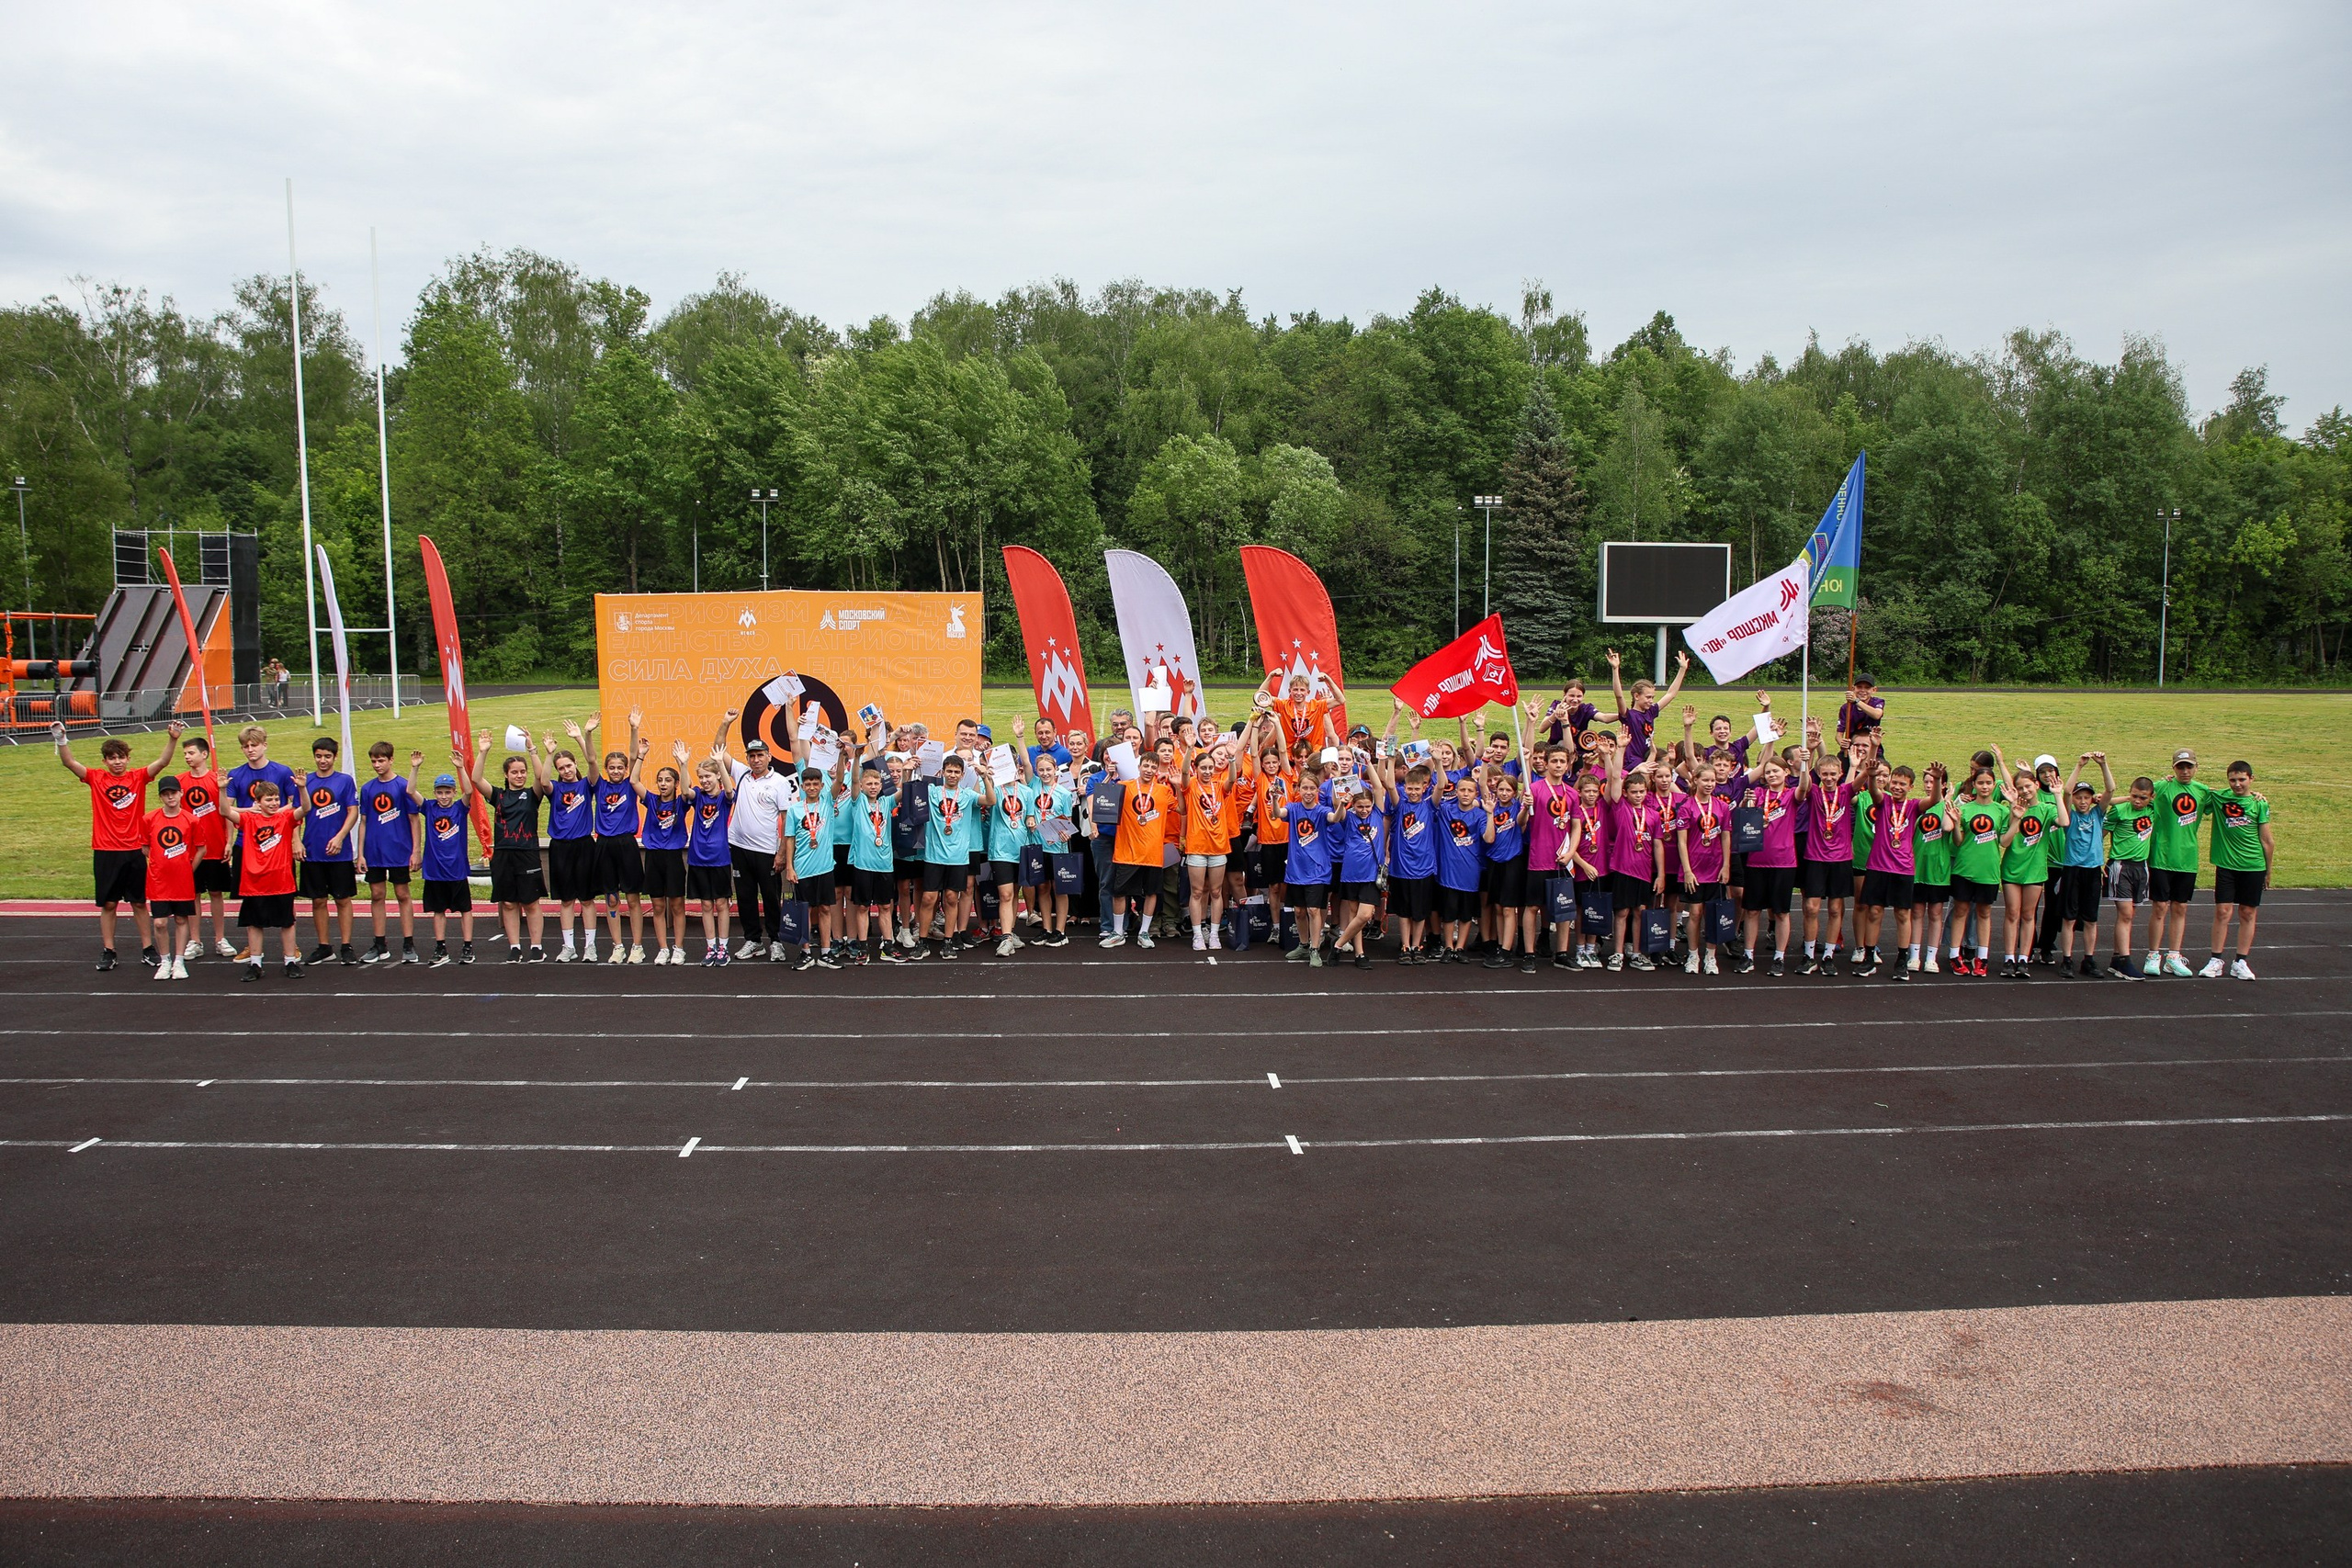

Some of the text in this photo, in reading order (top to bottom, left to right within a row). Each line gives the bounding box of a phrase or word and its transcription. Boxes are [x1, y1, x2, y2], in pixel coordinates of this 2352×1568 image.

[838, 607, 886, 620] МОСКОВСКИЙ
[838, 620, 861, 630] СПОРТ
[607, 629, 770, 657] ЕДИНСТВО
[607, 657, 970, 683] СИЛА ДУХА ЕДИНСТВО
[600, 686, 757, 709] АТРИОТИ
[895, 684, 979, 710] ДУХА
